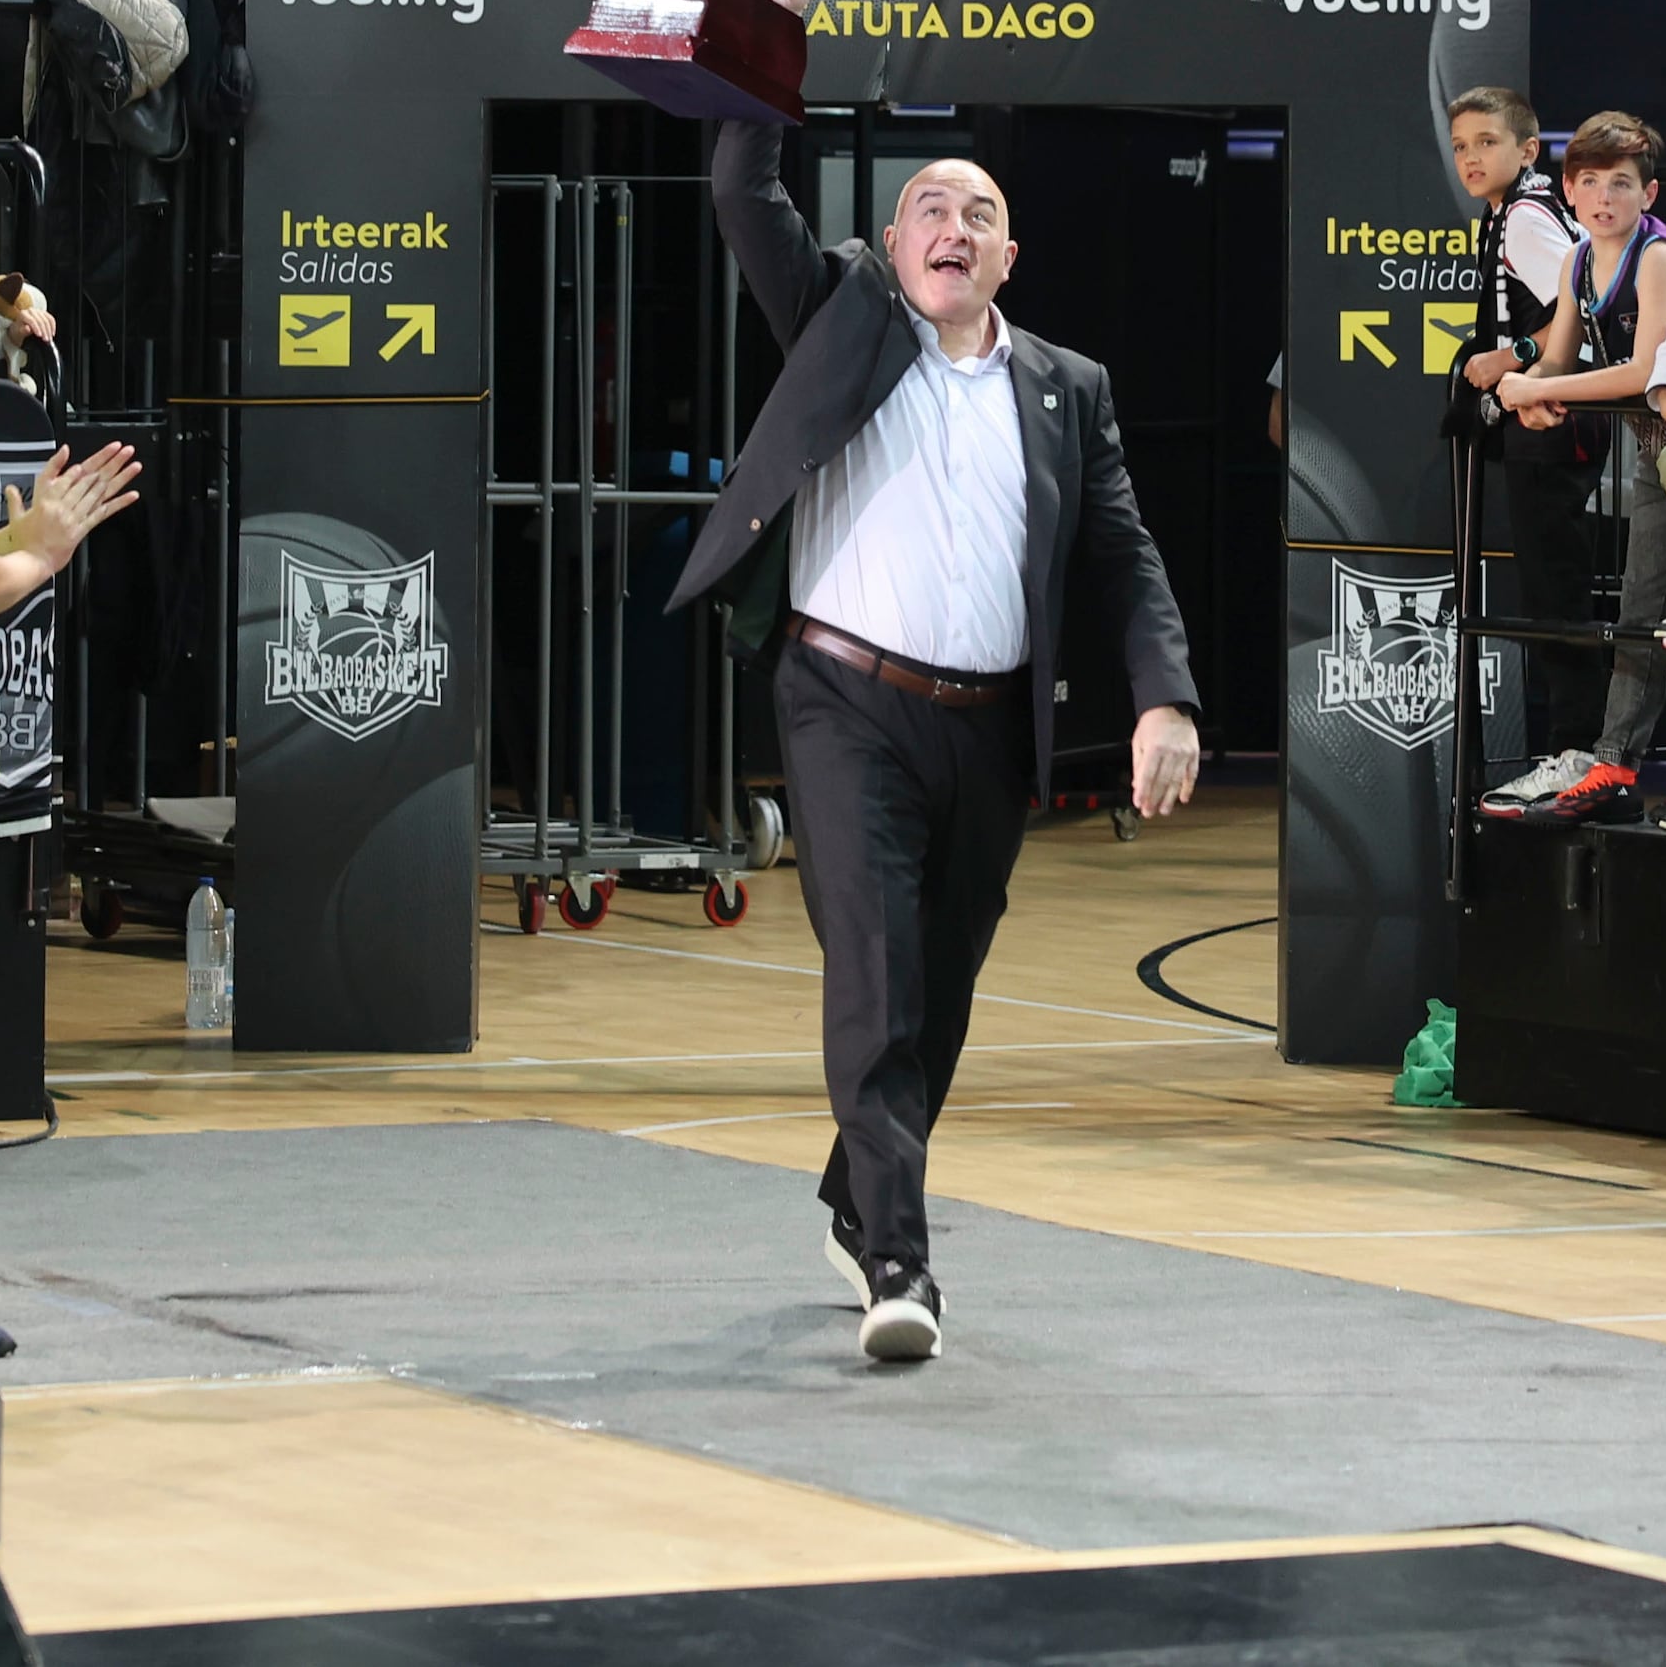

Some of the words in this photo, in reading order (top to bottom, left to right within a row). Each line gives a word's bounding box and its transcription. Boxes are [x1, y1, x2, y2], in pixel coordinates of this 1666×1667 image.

[962, 1, 1097, 40] DAGO
[281, 209, 449, 249] Irteerak
[279, 250, 394, 284] Salidas
[271, 646, 441, 697] BILBAOBASKET
[1325, 654, 1494, 708] BILBAOBASKT
